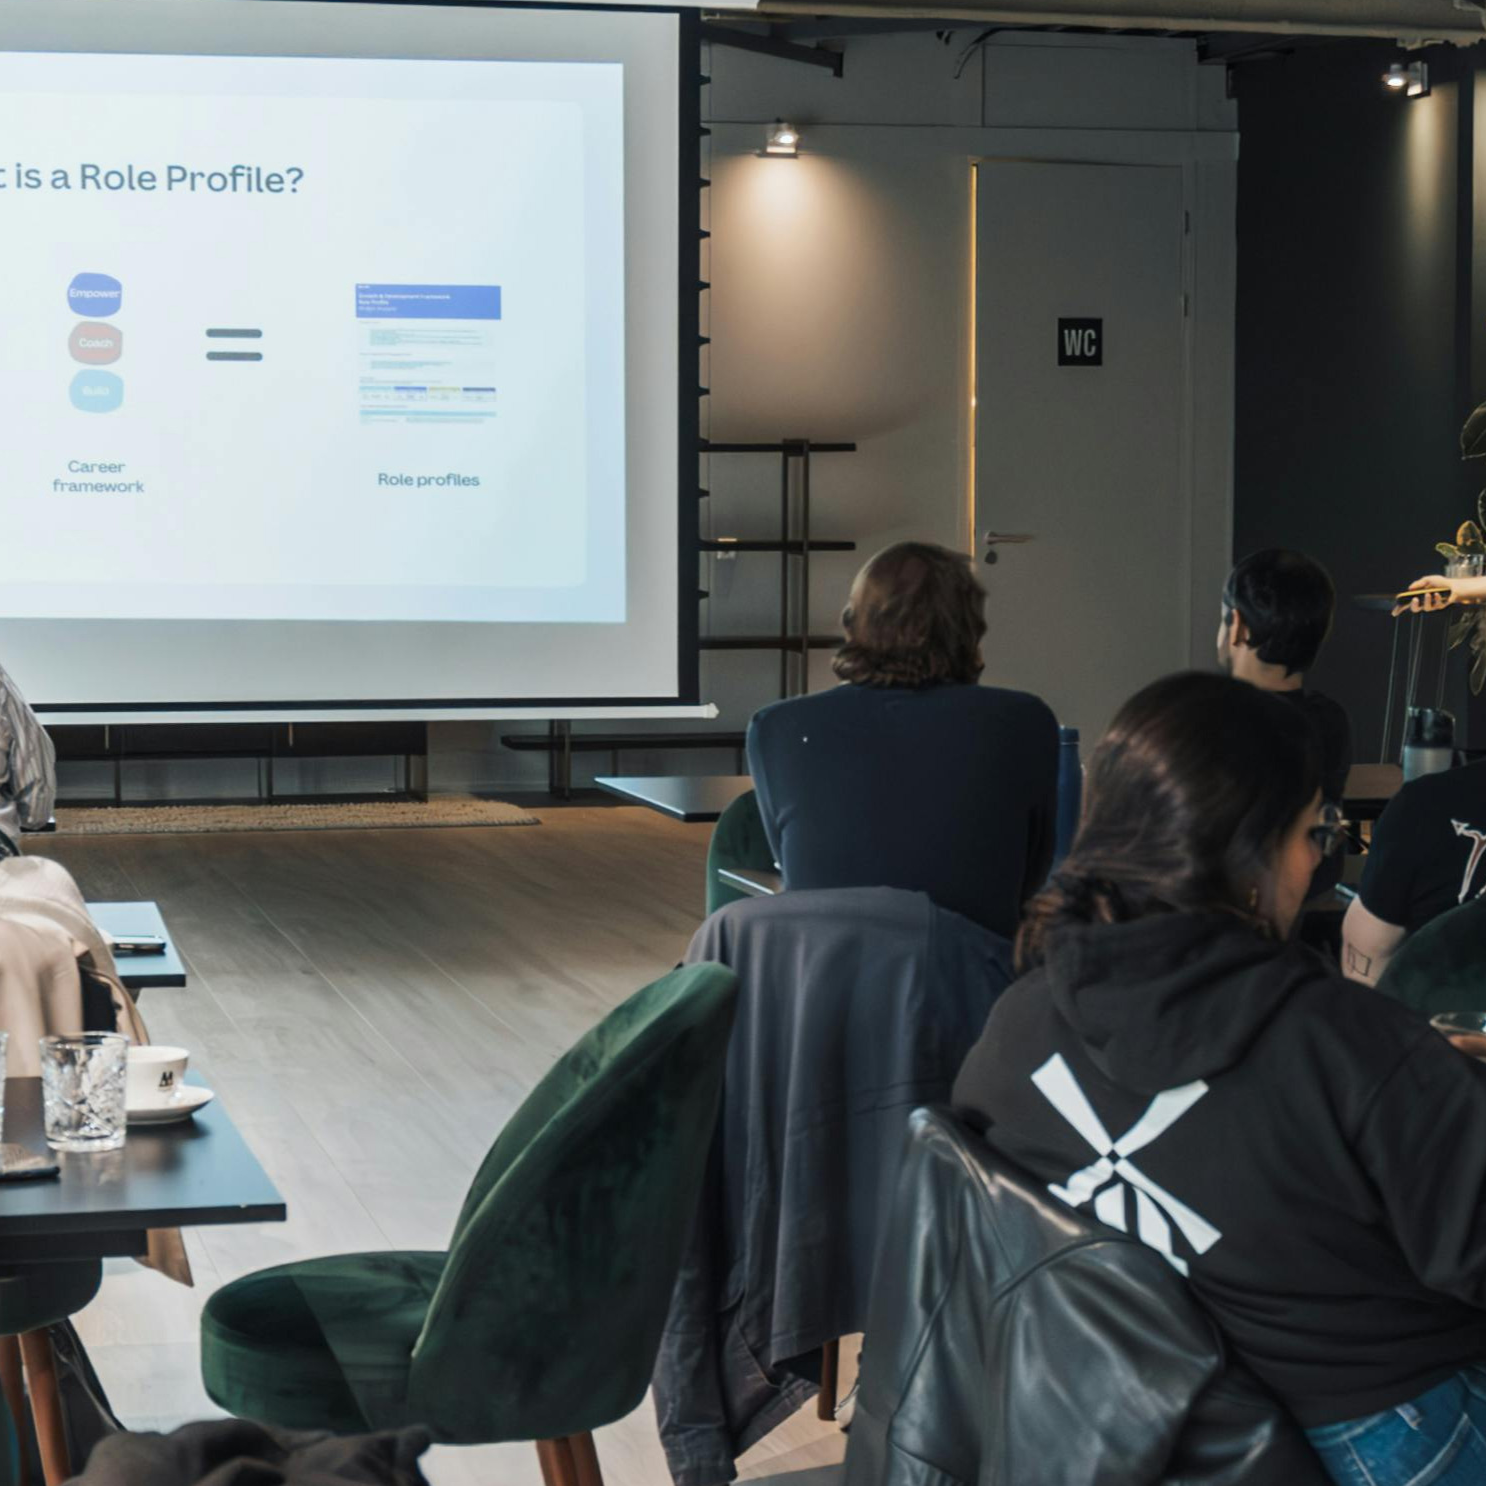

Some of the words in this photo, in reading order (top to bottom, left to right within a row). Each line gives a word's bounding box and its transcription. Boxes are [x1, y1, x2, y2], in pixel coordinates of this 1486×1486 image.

[15, 162, 43, 189] is
[50, 168, 72, 190] a
[80, 163, 157, 192] Role
[166, 164, 305, 194] Profile?
[69, 287, 121, 300] Empower
[78, 337, 114, 349] Coach
[1063, 328, 1097, 357] WC
[67, 459, 126, 474] Career
[52, 478, 145, 494] framework
[377, 472, 414, 487] Role
[416, 472, 481, 489] profiles
